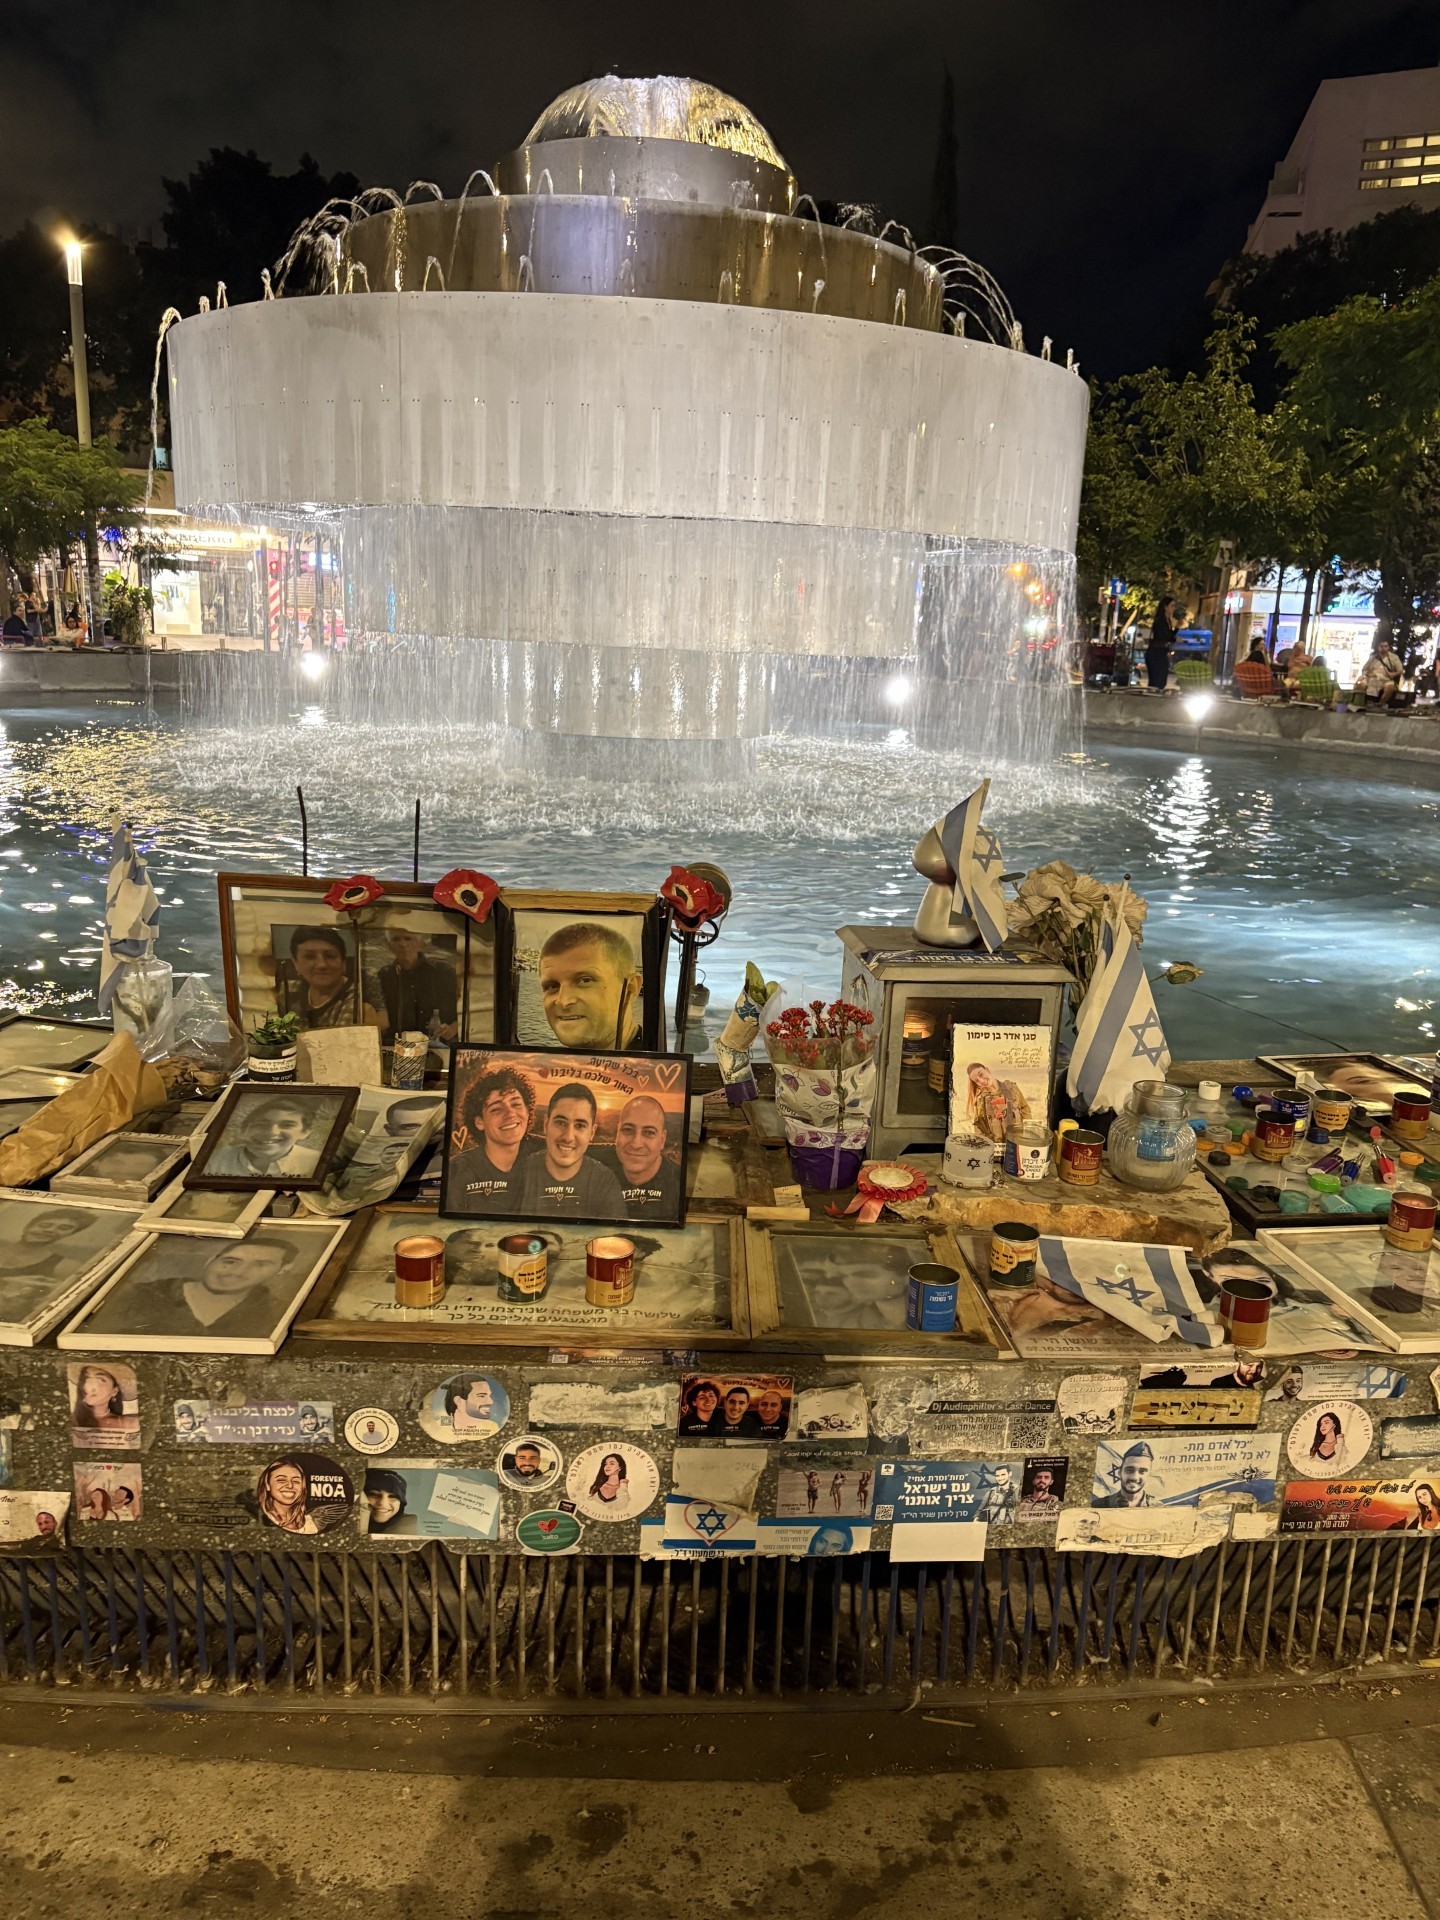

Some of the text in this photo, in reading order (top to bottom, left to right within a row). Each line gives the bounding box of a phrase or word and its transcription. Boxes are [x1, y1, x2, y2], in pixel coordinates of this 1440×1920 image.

[967, 1031, 1036, 1041] סגן אדר בן סימון
[623, 1062, 639, 1079] בכל
[550, 1066, 634, 1096] האור שלכם בליבנו
[621, 1188, 646, 1199] אלקבץ
[551, 1306, 604, 1316] משפחה
[609, 1307, 629, 1316] בני
[634, 1308, 680, 1320] שלושה
[489, 1314, 532, 1323] אליכם
[1068, 1337, 1098, 1346] שושן
[263, 1405, 296, 1417] לנצח
[932, 1403, 942, 1412] Dj
[1004, 1402, 1023, 1411] Last
[1025, 1402, 1051, 1410] Dance
[1321, 1402, 1334, 1410] כמו
[1302, 1408, 1317, 1421] שמש
[273, 1425, 296, 1436] עדי
[587, 1445, 604, 1456] שמש
[1240, 1450, 1252, 1460] כל
[1256, 1449, 1271, 1459] לא
[1178, 1453, 1211, 1463] באמת
[1214, 1451, 1237, 1461] אדם
[310, 1474, 344, 1483] FOREVER
[310, 1483, 346, 1498] NOA
[903, 1482, 970, 1494] עם ישראל
[946, 1493, 974, 1507] צריך
[955, 1510, 968, 1518] סרן
